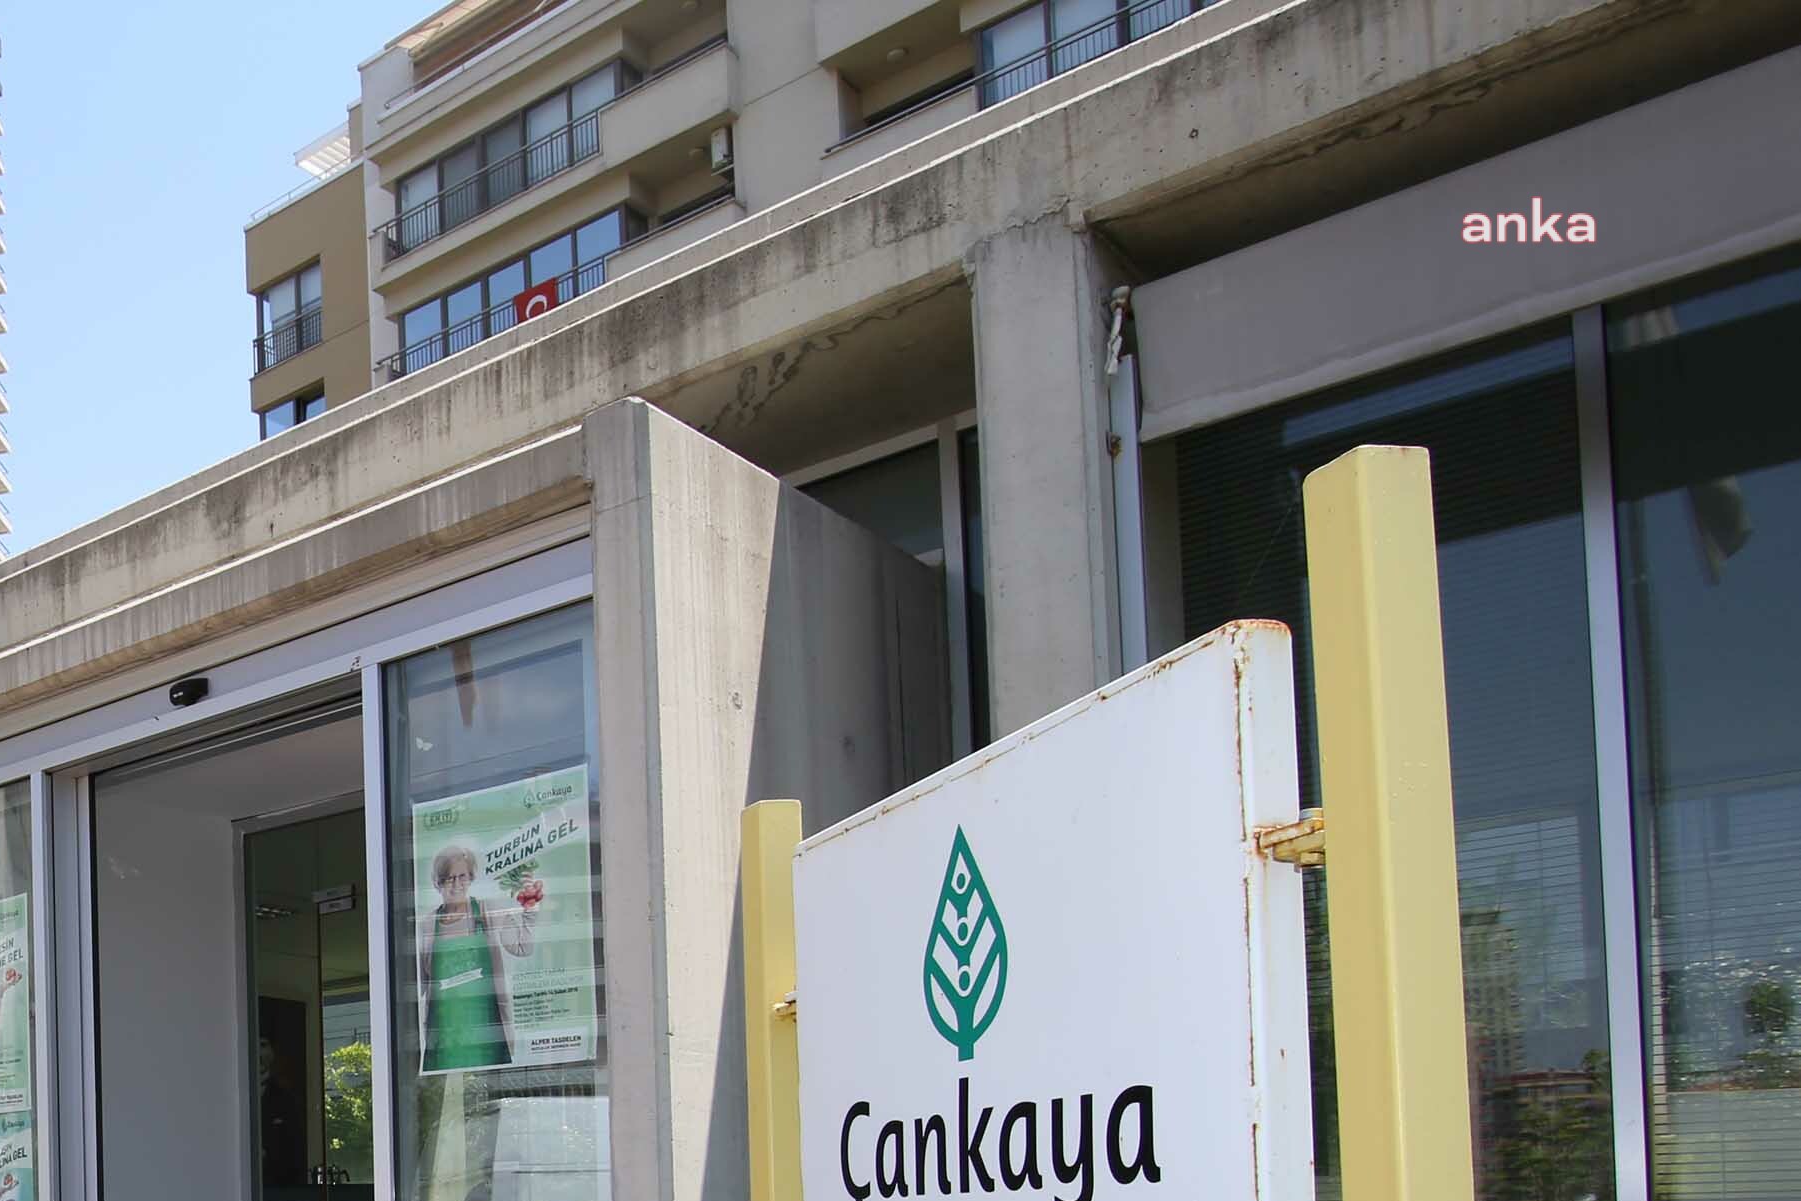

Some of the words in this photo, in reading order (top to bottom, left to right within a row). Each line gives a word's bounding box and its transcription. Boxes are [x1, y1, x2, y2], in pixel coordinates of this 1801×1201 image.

[485, 838, 544, 875] KRALINA
[547, 818, 579, 844] GEL
[486, 823, 541, 862] TURBUN
[7, 948, 24, 963] GEL
